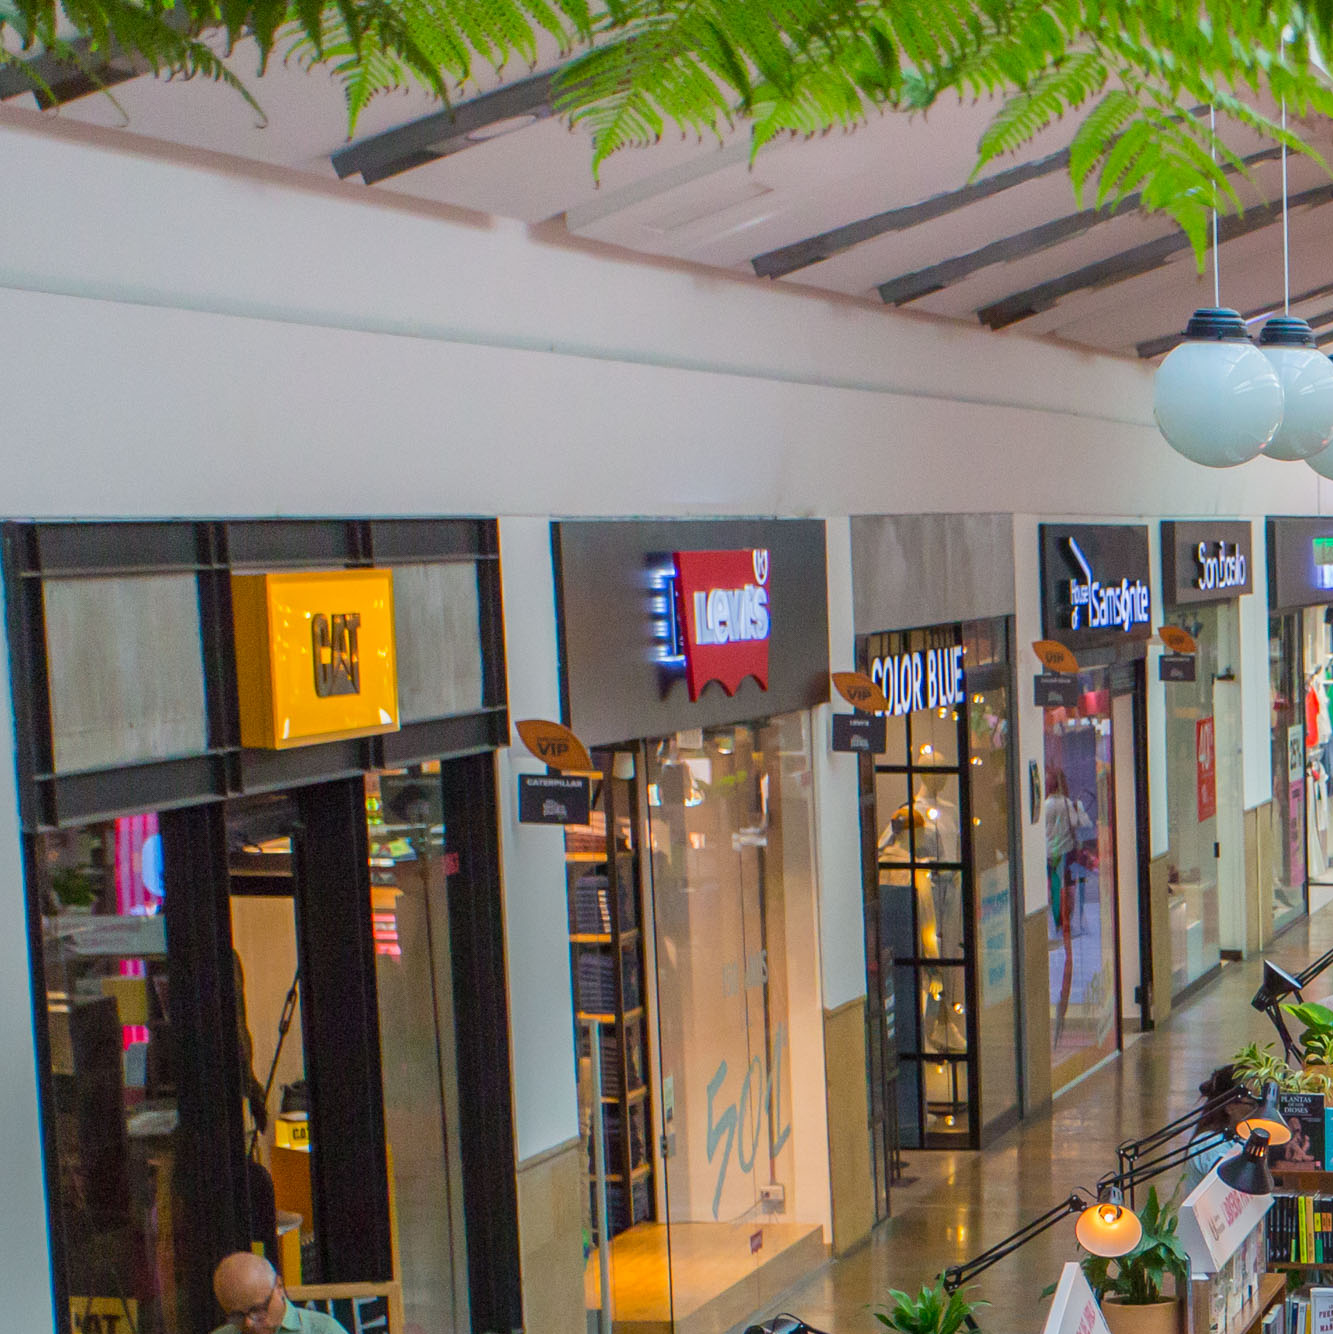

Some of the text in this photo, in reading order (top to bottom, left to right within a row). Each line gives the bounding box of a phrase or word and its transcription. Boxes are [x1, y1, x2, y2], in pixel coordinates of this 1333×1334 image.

[311, 612, 362, 698] CAT
[926, 645, 965, 709] BLUE
[538, 742, 568, 756] VIP
